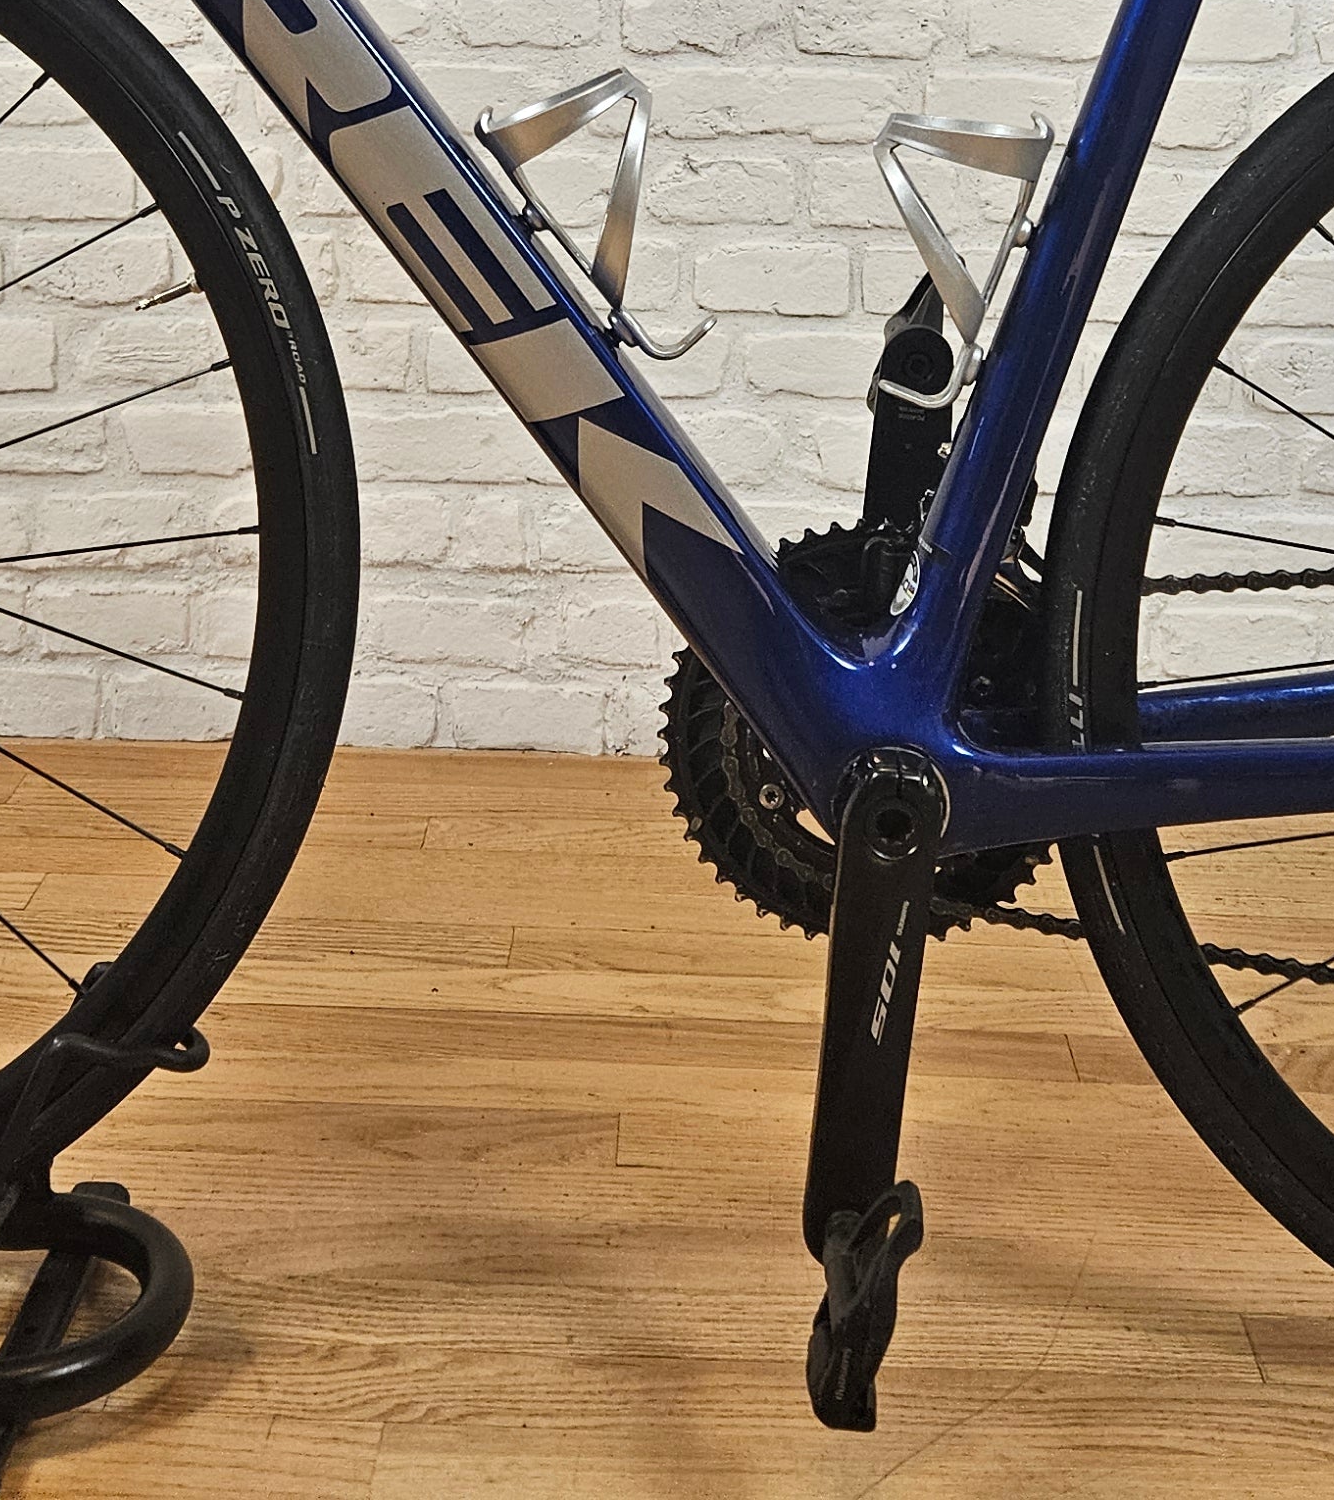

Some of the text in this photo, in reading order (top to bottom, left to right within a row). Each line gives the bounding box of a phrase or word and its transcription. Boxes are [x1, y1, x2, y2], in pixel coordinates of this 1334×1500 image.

[216, 195, 307, 384] P ZERO ROAD
[870, 940, 902, 1046] 105
